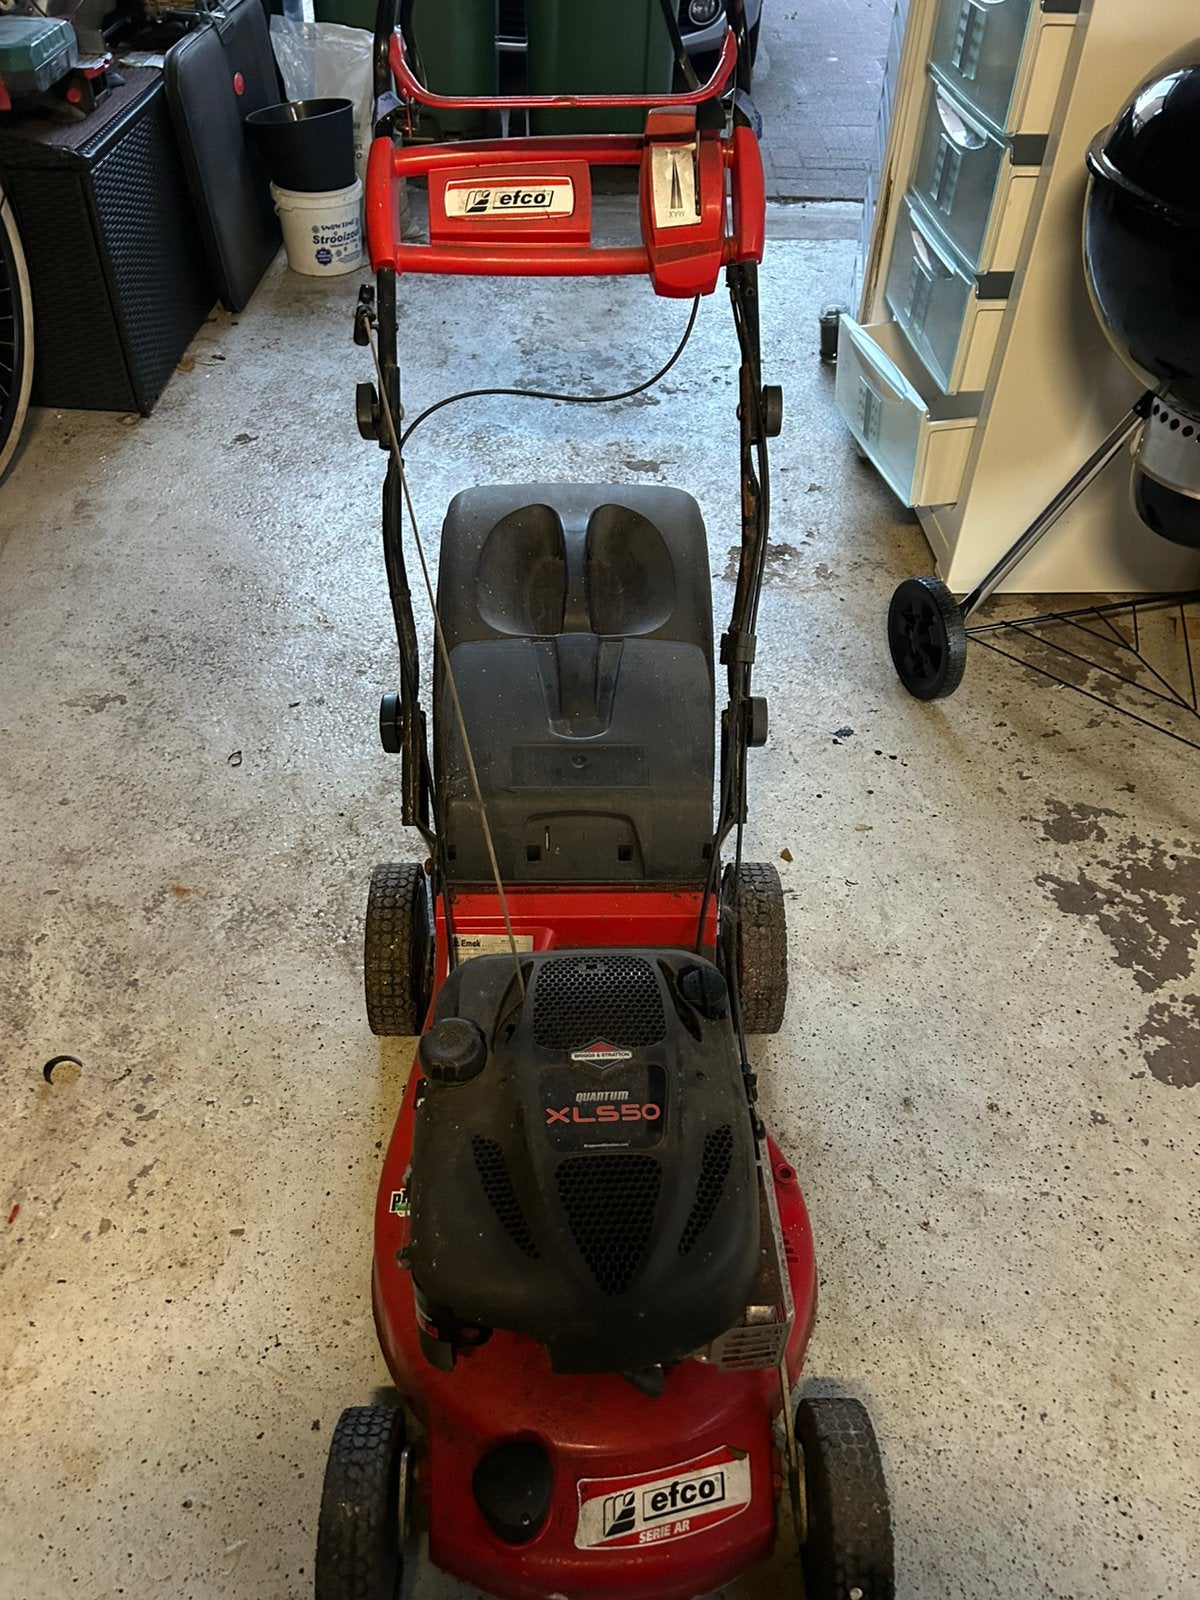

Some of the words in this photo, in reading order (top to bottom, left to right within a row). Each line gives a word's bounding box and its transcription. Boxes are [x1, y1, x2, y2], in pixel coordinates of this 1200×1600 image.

[500, 189, 546, 206] efco
[461, 939, 481, 947] Emak
[575, 1090, 629, 1102] QUANTUM
[545, 1103, 661, 1125] XLS50
[650, 1480, 716, 1513] efco
[638, 1524, 671, 1544] SERIE
[673, 1519, 691, 1534] AR
